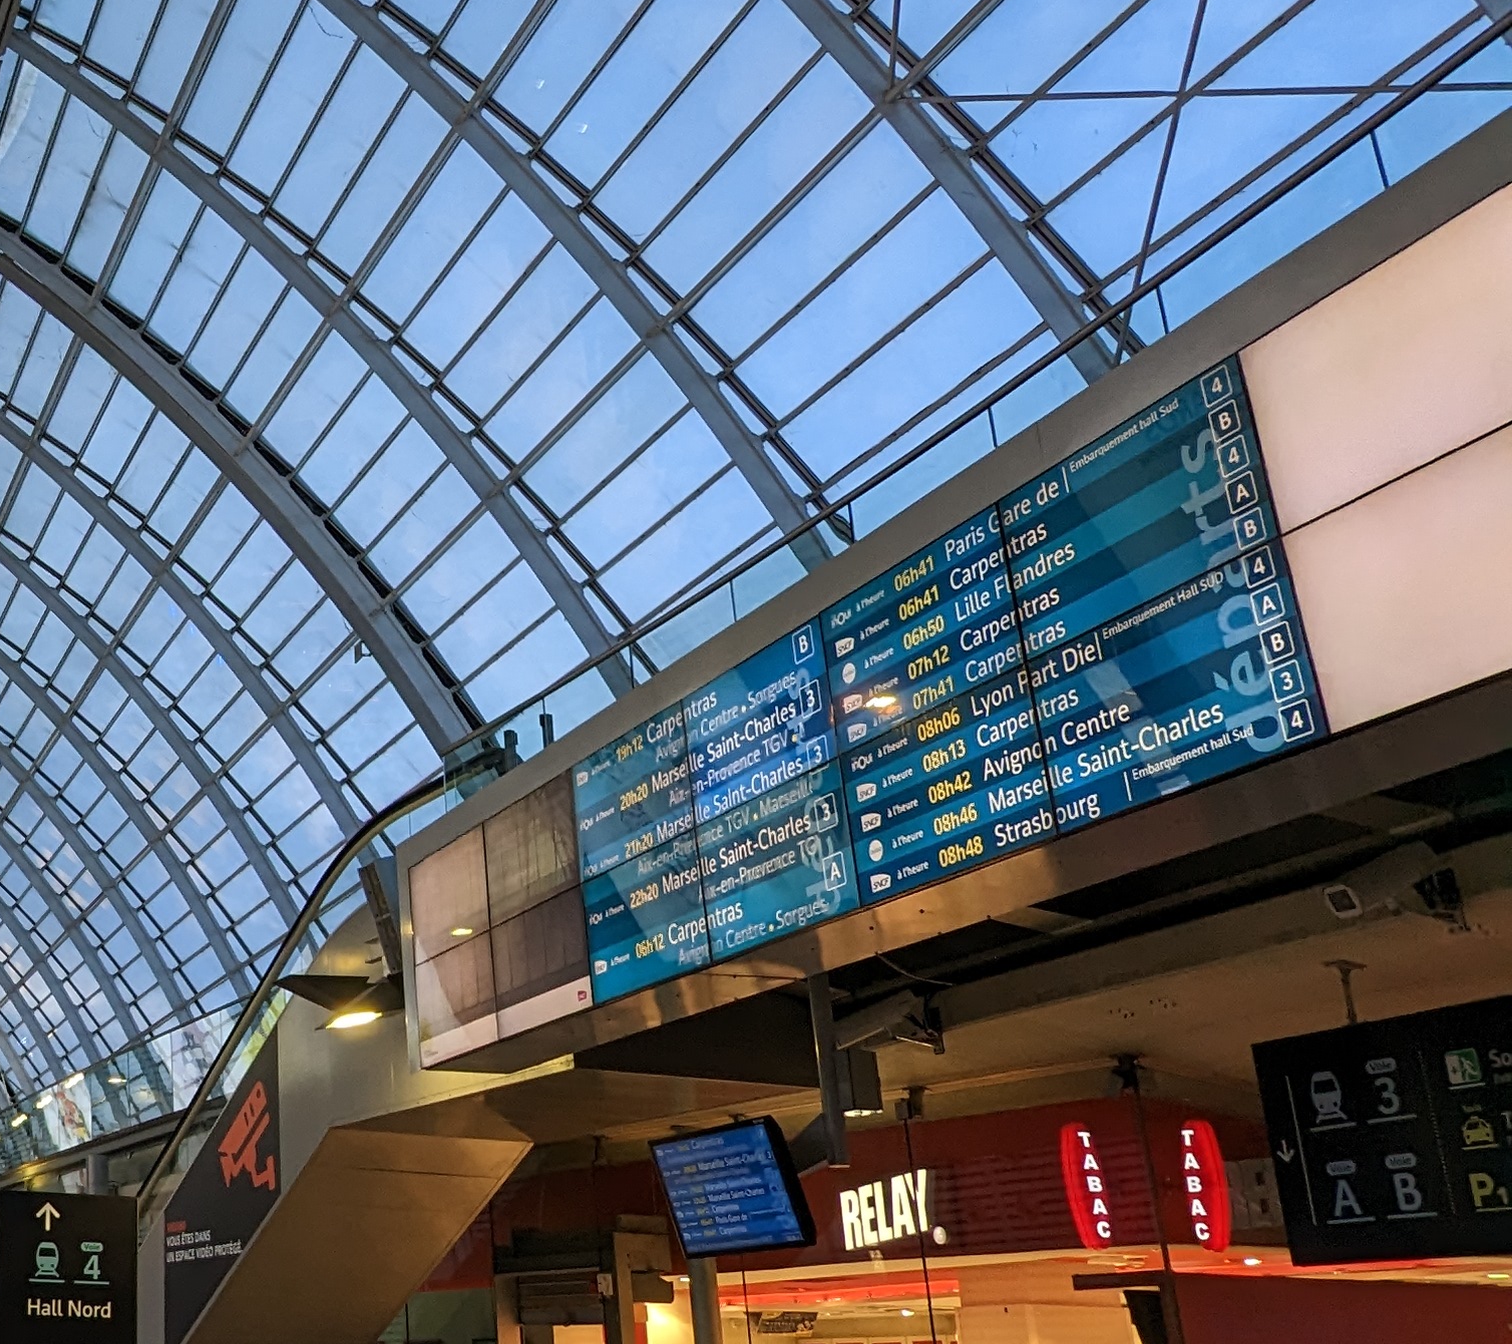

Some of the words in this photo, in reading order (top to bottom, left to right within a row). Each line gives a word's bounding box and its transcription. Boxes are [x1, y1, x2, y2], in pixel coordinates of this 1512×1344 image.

[894, 555, 935, 592] 06h41
[944, 525, 986, 562] Paris
[988, 498, 1032, 534] Gare
[1036, 481, 1060, 506] de
[1069, 424, 1139, 472] Embarquement
[1139, 412, 1159, 431] hall
[1159, 398, 1179, 417] Sud
[1211, 376, 1223, 394] 4
[898, 584, 940, 621] 06h41
[949, 522, 1048, 590] Carpentras
[1218, 412, 1231, 431] B
[903, 615, 945, 651] 06h50
[955, 590, 991, 622] Lille
[993, 541, 1076, 600] Flandres
[1228, 447, 1239, 464] 4
[907, 645, 950, 681] 07h12
[959, 586, 1061, 652] Carpentras
[1236, 484, 1250, 503] A
[912, 675, 955, 710] 07h41
[965, 619, 1066, 683] Carpentras
[1244, 519, 1257, 537] B
[917, 707, 961, 742] 08h06
[971, 683, 1014, 717] Lyon
[1017, 661, 1059, 694] Part
[1062, 642, 1096, 673] Die
[1102, 597, 1176, 640] Embarquement
[1177, 585, 1199, 604] Hall
[1200, 570, 1224, 591] SUD
[1253, 557, 1265, 575] 4
[647, 691, 717, 743] Carpentras
[798, 635, 809, 654] B
[700, 706, 738, 736] Centre
[922, 738, 967, 773] 08h13
[976, 688, 1079, 748] Carpentras
[1262, 596, 1277, 615] A
[927, 770, 972, 805] 08h42
[983, 736, 1057, 781] Avignon
[1061, 704, 1131, 746] Centre
[1270, 633, 1285, 652] B
[619, 783, 649, 811] 20h20
[651, 753, 705, 793] Marseille
[706, 701, 796, 763] Saint-Charles
[806, 690, 816, 706] 3
[762, 729, 789, 756] TGV
[933, 802, 978, 835] 08h46
[988, 765, 1073, 814] Marseille
[1077, 704, 1224, 778] Saint-Charles
[1280, 672, 1294, 691] 3
[938, 835, 984, 868] 08h48
[994, 793, 1101, 847] Strasbourg
[1132, 745, 1208, 781] Embarquement
[1210, 733, 1231, 750] hall
[1232, 724, 1255, 741] Sud
[1291, 710, 1304, 729] 4
[624, 831, 654, 860] 21h20
[656, 804, 710, 843] Marseille
[713, 757, 804, 815] Saint-Charles
[813, 745, 822, 763] 3
[629, 883, 659, 909] 22h20
[662, 856, 717, 894] Marseille
[719, 812, 812, 868] Saint-Charles
[821, 803, 831, 821] 3
[668, 902, 743, 945] Carpentras
[830, 862, 841, 881] A
[1374, 1077, 1400, 1115] 3
[839, 1168, 929, 1251] RELAY
[1077, 1131, 1111, 1239] TABAC
[1181, 1129, 1210, 1241] TABAC
[1334, 1179, 1363, 1217] A
[1392, 1172, 1422, 1212] B
[27, 1298, 63, 1317] Hall
[68, 1300, 111, 1319] Nord
[83, 1255, 101, 1280] 4
